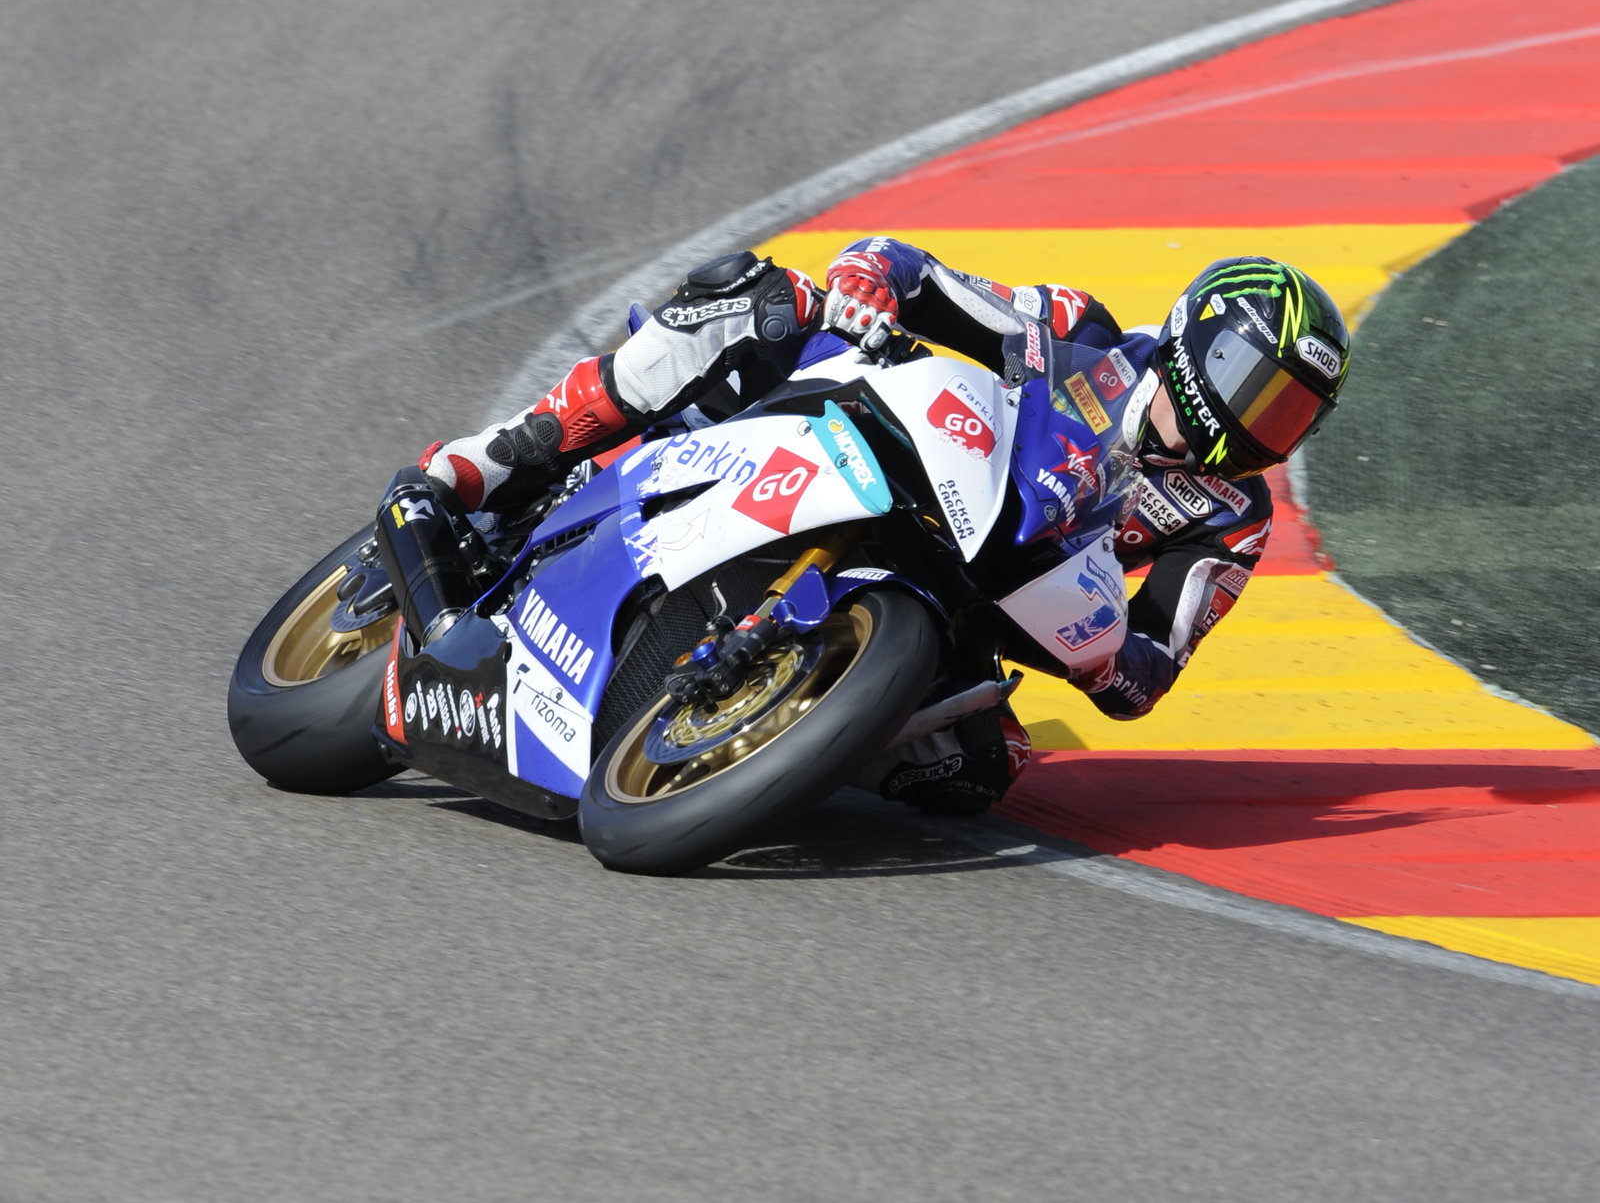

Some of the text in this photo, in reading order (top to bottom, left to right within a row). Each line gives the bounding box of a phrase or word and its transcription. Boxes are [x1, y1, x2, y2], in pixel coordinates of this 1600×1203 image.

[1098, 371, 1119, 388] GO
[1304, 340, 1338, 375] SHOEI
[1069, 378, 1107, 429] PIRELLI
[1167, 360, 1199, 427] ENERGY
[1173, 337, 1221, 438] MONSTER
[944, 413, 983, 436] GO
[658, 432, 757, 487] Parkin
[751, 465, 809, 503] GO
[832, 429, 878, 491] MOTOREX
[937, 482, 967, 540] CARBON
[945, 479, 976, 537] BECKER
[1036, 467, 1077, 528] YAMAHA
[1137, 495, 1175, 533] ARBON
[1141, 484, 1183, 530] BECKER
[1168, 474, 1206, 513] SHOEI
[518, 587, 595, 686] YAMAHA
[386, 659, 398, 727] bitubo
[1113, 671, 1148, 708] arkin
[530, 691, 577, 743] rizoma
